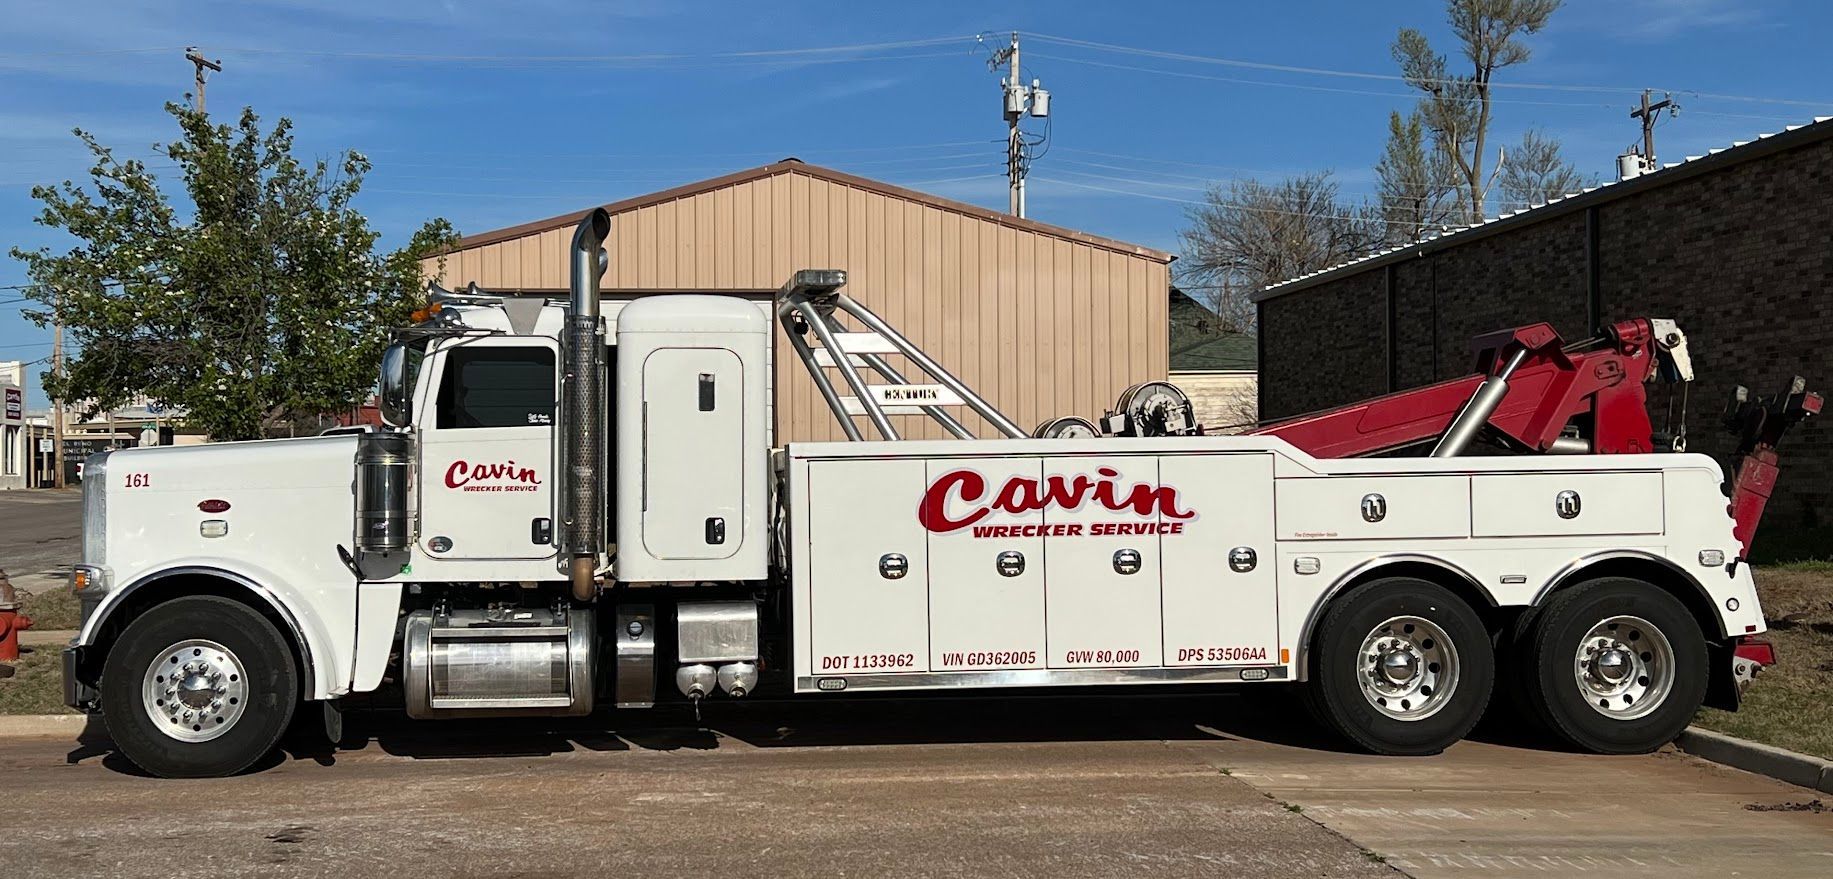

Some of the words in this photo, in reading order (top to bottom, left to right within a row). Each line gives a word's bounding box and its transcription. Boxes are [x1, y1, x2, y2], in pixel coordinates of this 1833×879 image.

[884, 389, 937, 400] CENTURY
[124, 473, 150, 488] 161
[444, 459, 542, 489] Cavin
[504, 484, 538, 492] SERVICE
[918, 466, 1196, 534] Cavin
[972, 524, 1083, 540] WRECKER
[1089, 522, 1184, 537] SERVICE
[822, 654, 850, 670] DOT
[852, 653, 915, 669] 1133962
[942, 652, 965, 667] VIN
[966, 651, 1037, 667] GD362005
[1066, 650, 1094, 664] GVW
[1095, 649, 1140, 665] 80,000
[1178, 648, 1204, 663] DPS
[1206, 646, 1268, 662] 53506AA
